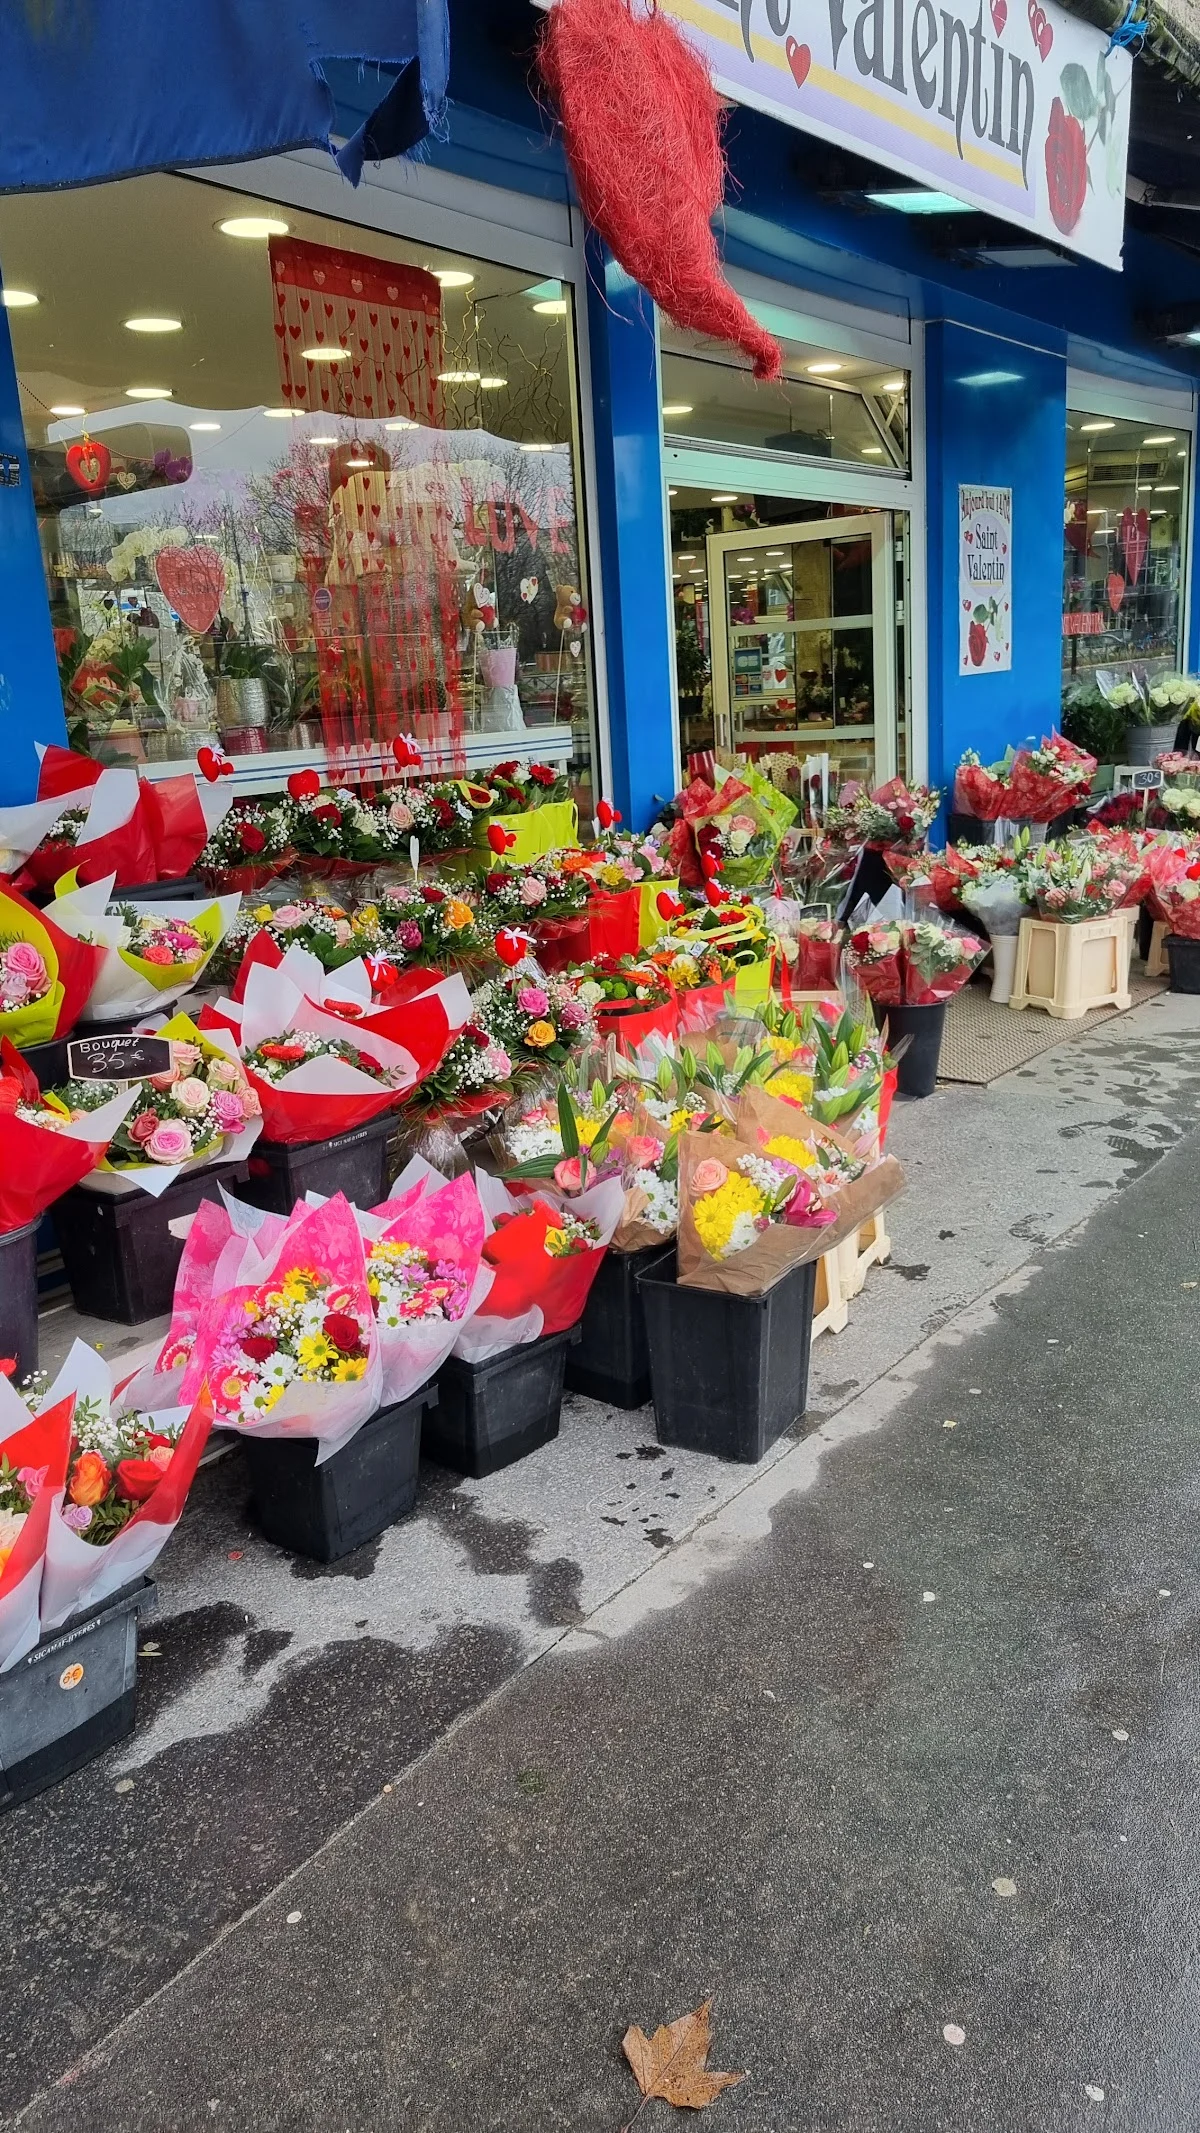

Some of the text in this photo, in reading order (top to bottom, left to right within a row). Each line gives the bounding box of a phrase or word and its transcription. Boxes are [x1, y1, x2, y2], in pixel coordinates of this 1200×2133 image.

[976, 523, 998, 554] Saint
[967, 554, 1005, 584] Valentin
[80, 1038, 140, 1053] Bouquet
[62, 1667, 81, 1684] 6€
